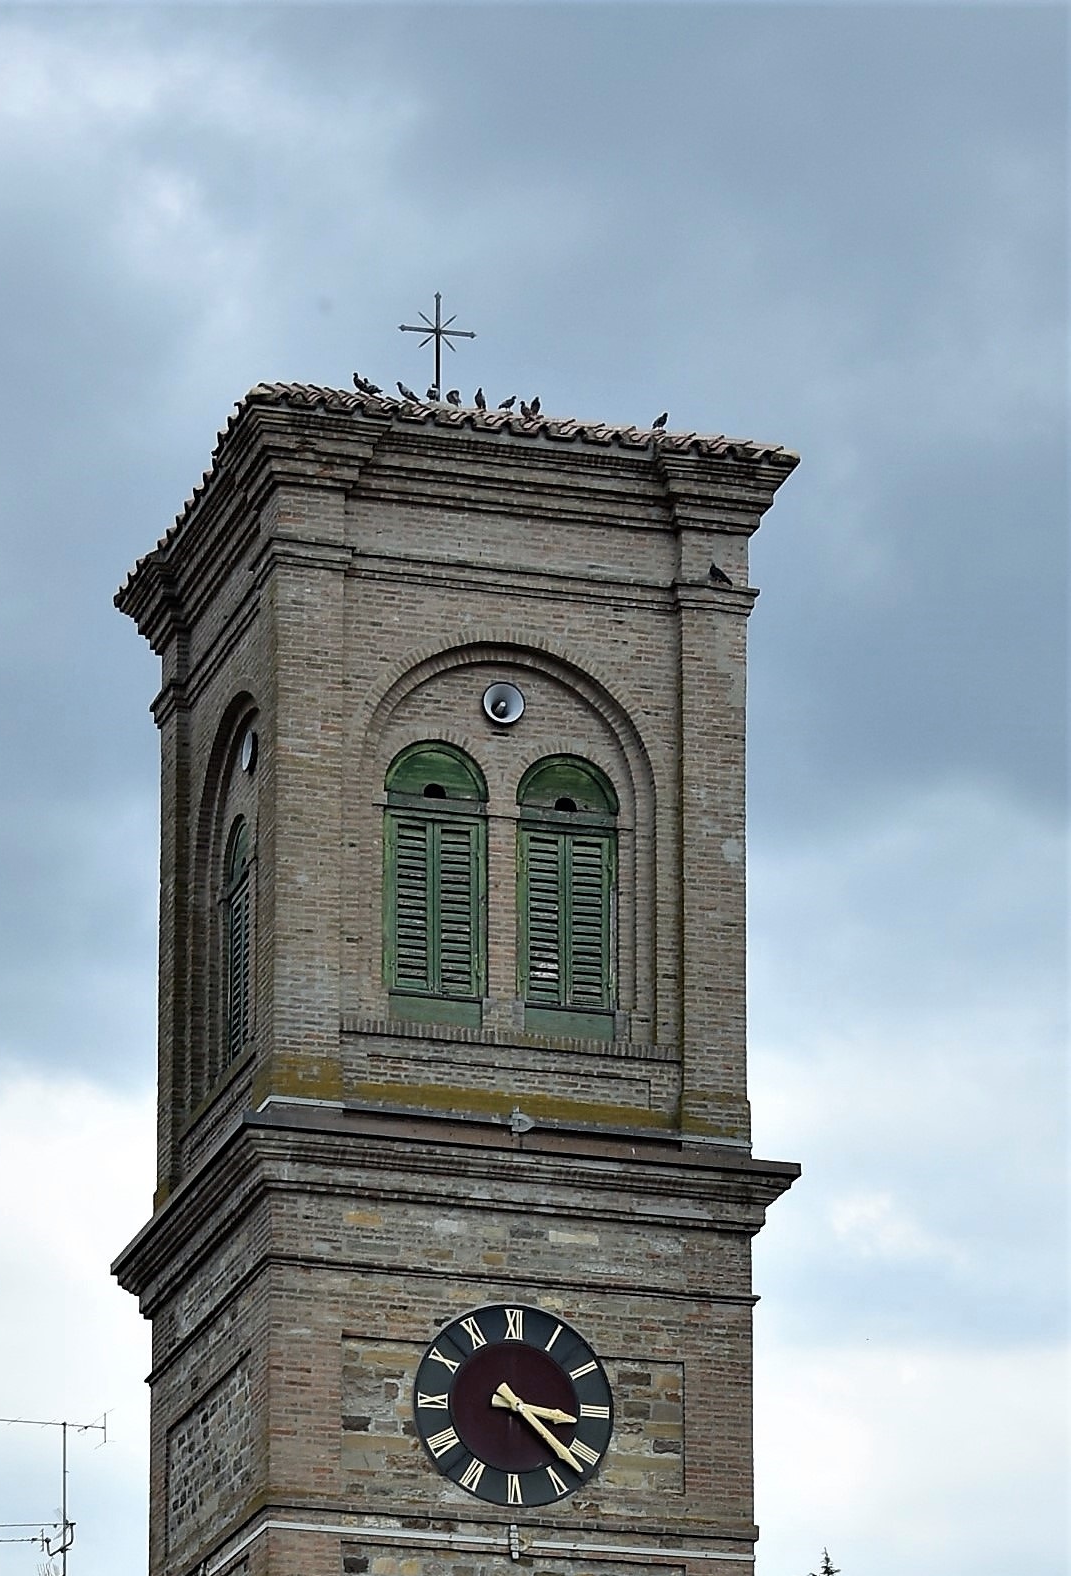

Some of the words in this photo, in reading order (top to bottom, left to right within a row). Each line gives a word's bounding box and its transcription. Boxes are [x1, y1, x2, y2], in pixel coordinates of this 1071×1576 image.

[459, 1316, 488, 1350] XI
[504, 1309, 524, 1341] XII
[545, 1324, 563, 1351] I
[428, 1347, 460, 1374] X
[569, 1360, 598, 1380] II
[417, 1392, 449, 1409] IX
[580, 1403, 610, 1419] III
[427, 1428, 460, 1459] VIII
[459, 1459, 486, 1492] VII
[507, 1473, 523, 1505] VI
[546, 1466, 569, 1496] V
